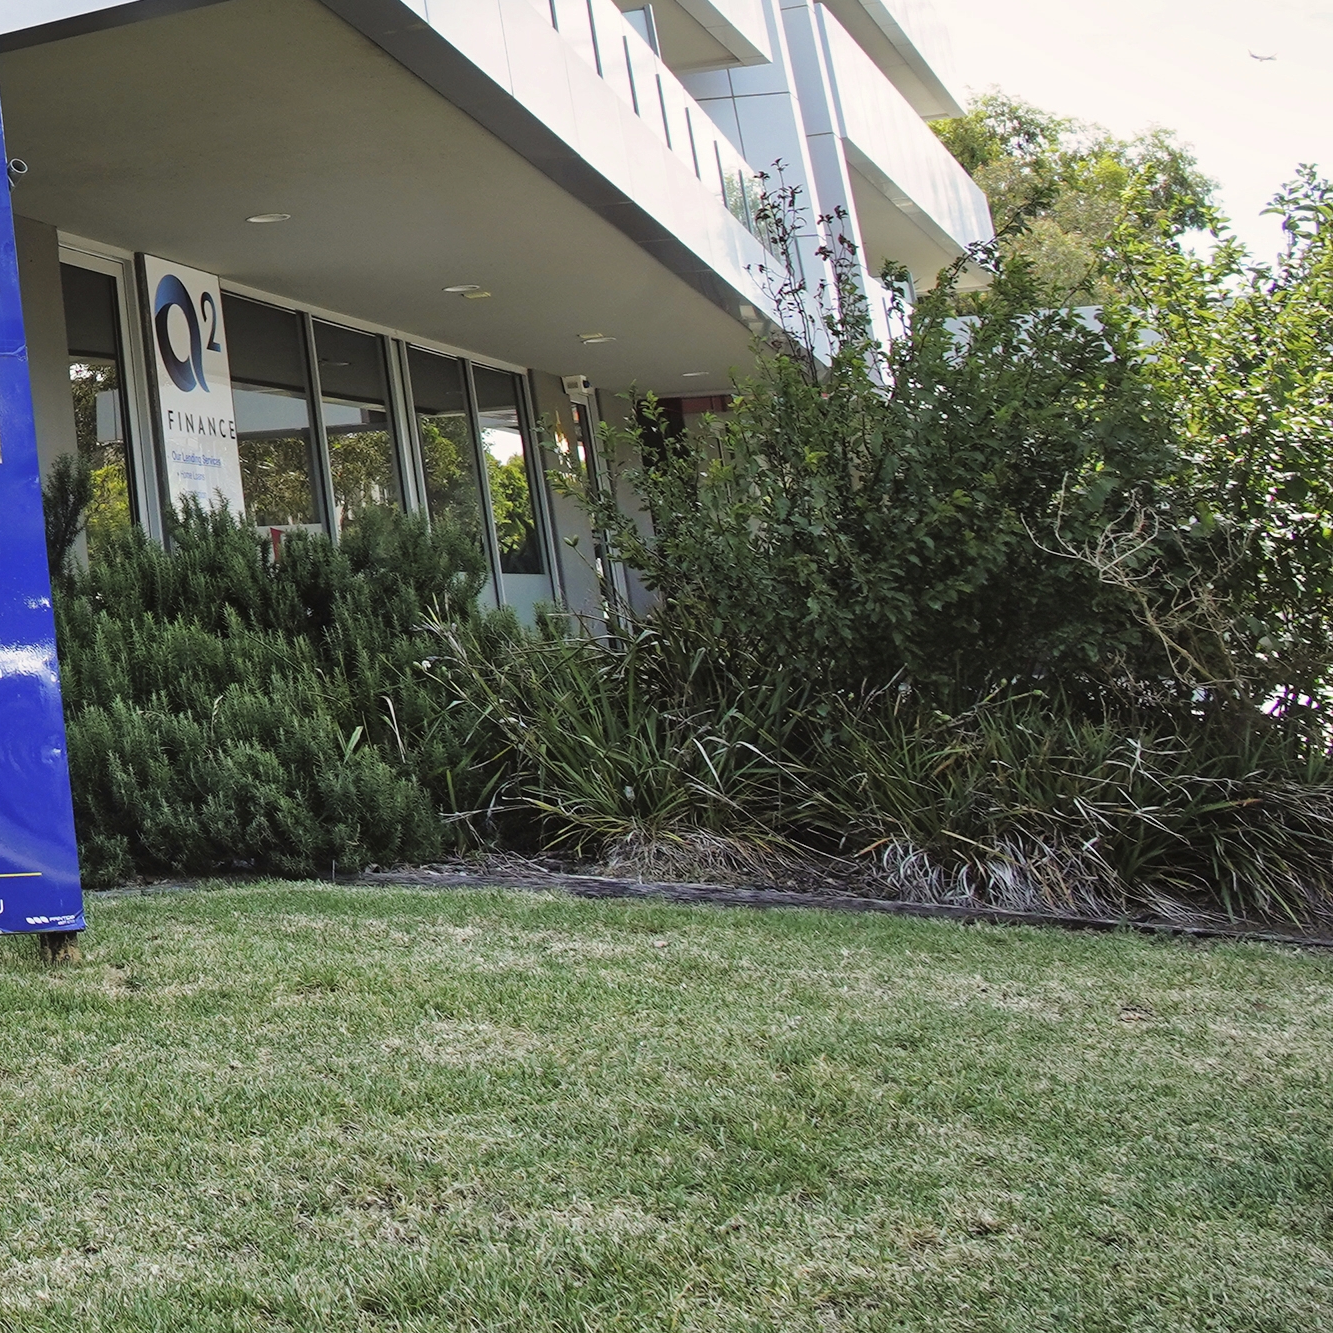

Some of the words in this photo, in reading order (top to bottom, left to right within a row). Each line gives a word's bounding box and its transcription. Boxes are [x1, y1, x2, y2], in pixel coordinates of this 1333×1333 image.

[167, 410, 237, 440] FINANCE
[172, 450, 181, 461] Our
[182, 452, 201, 466] Lending
[202, 454, 222, 467] Services
